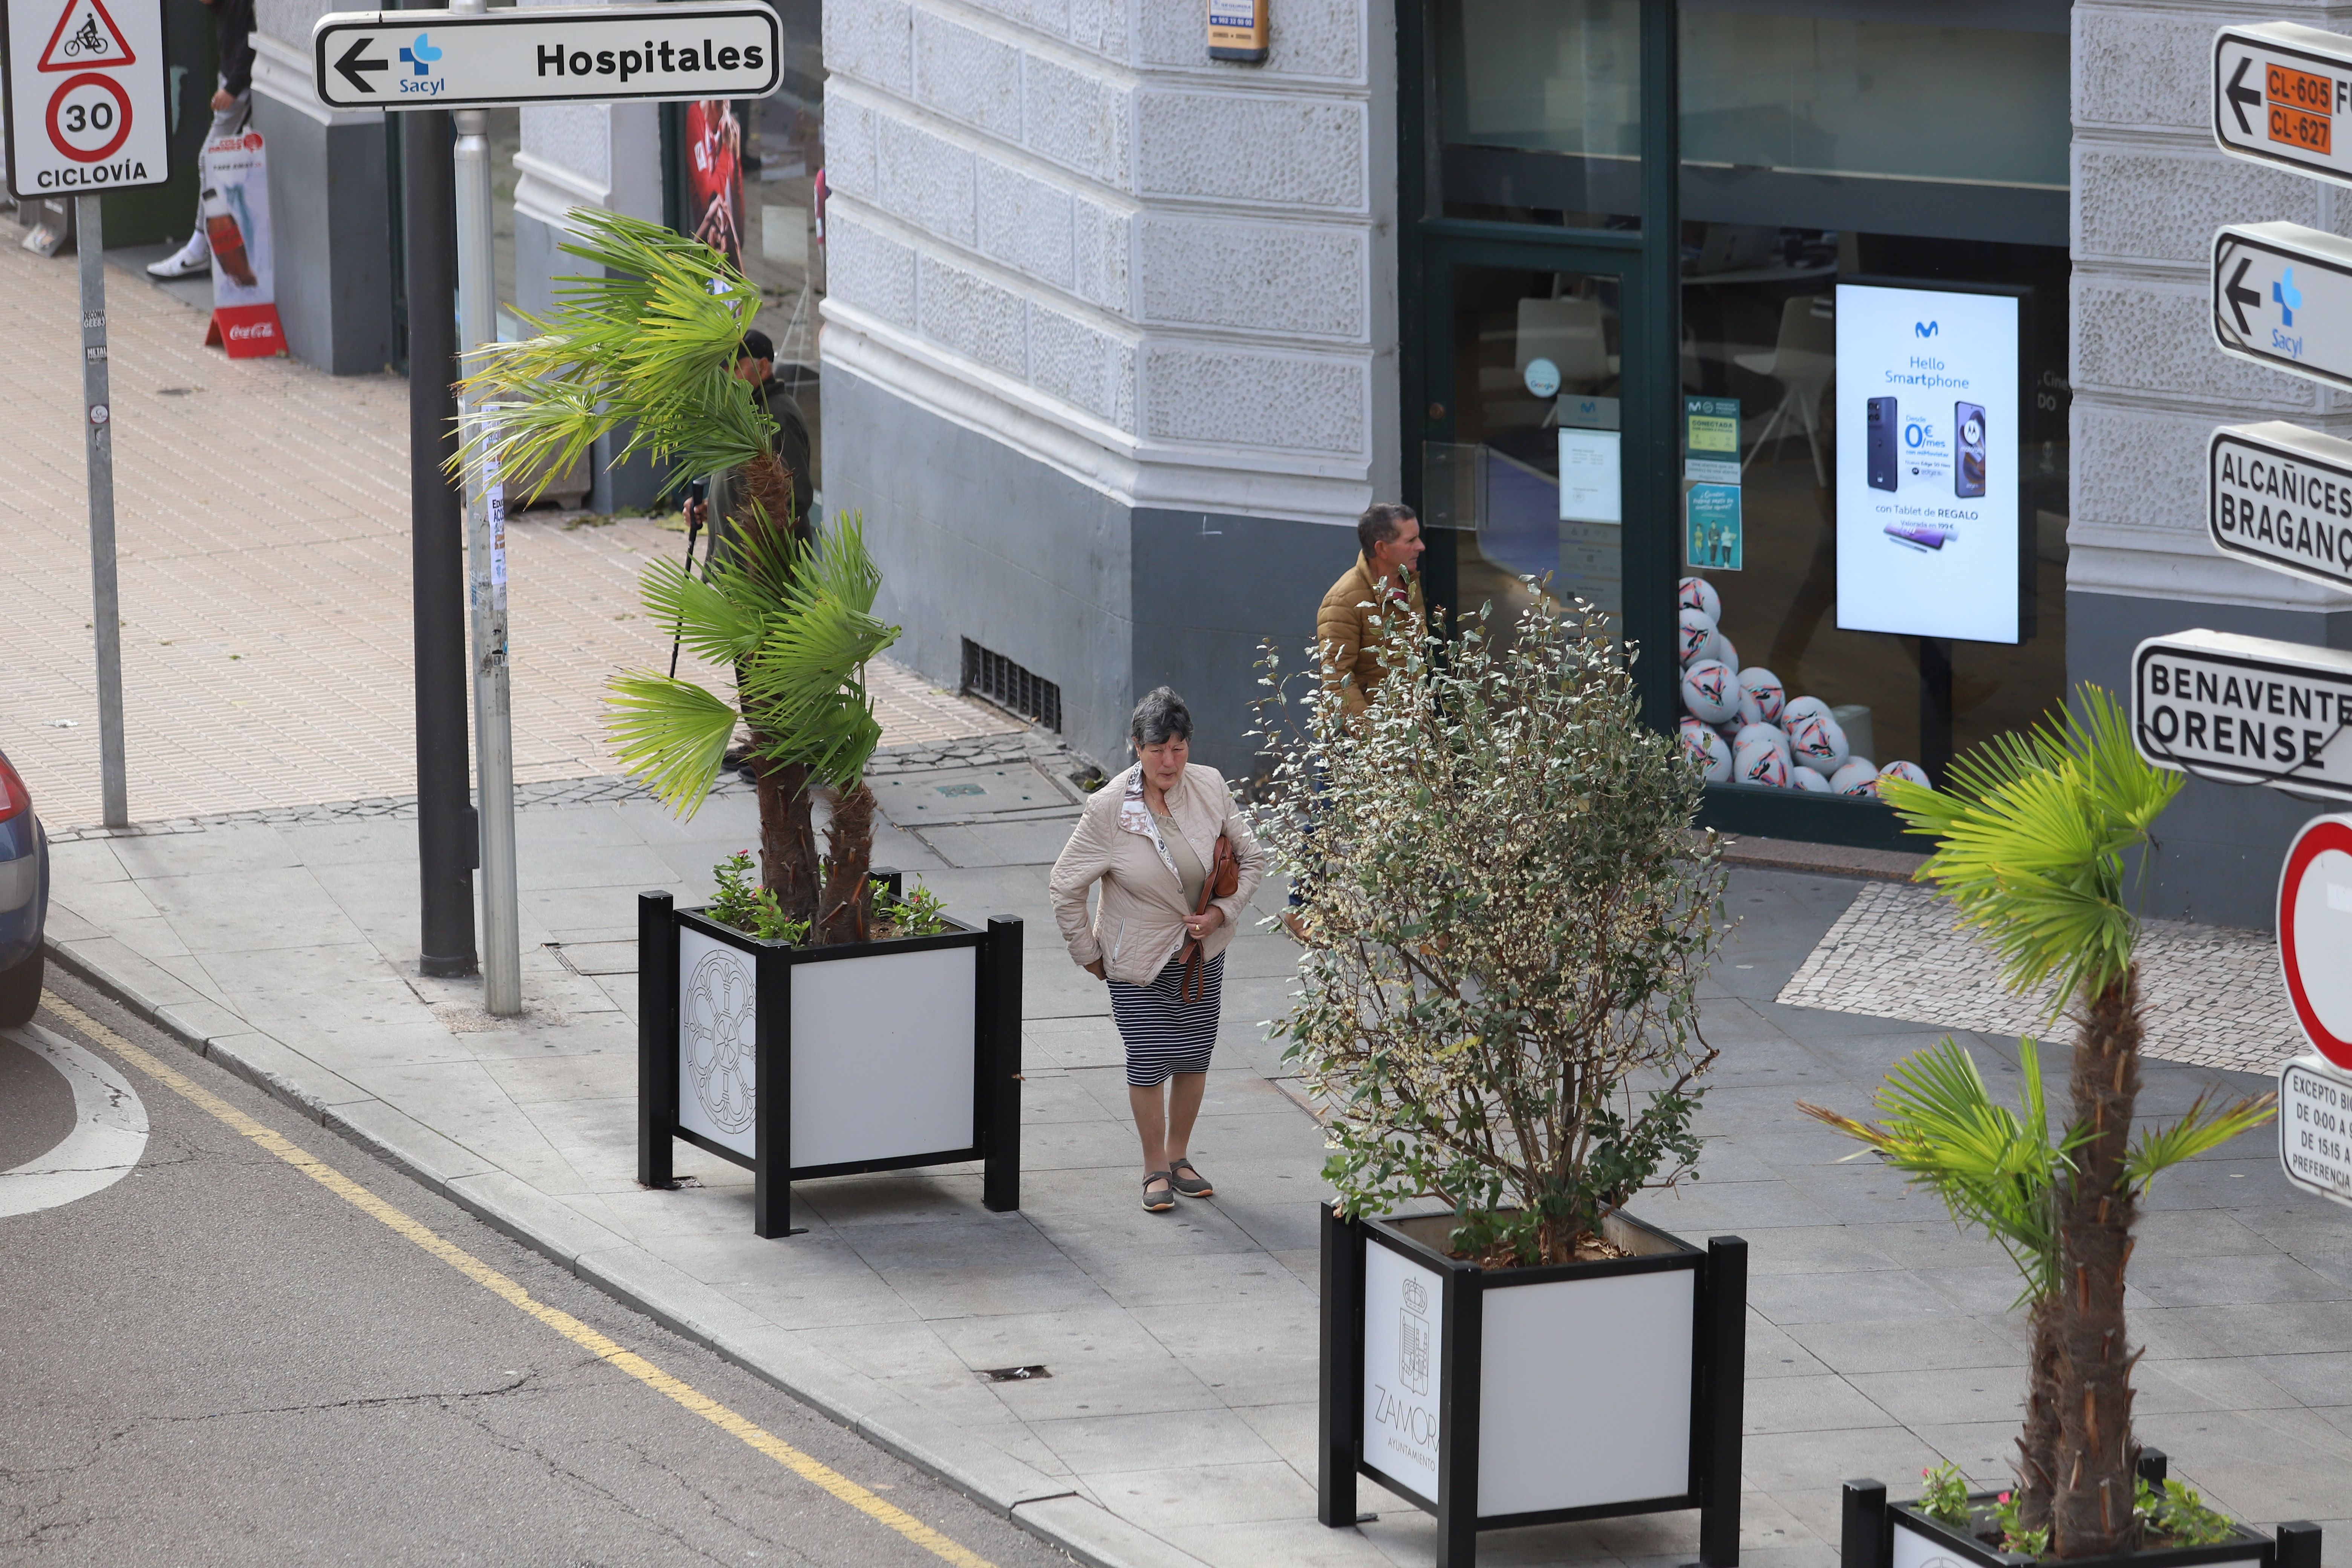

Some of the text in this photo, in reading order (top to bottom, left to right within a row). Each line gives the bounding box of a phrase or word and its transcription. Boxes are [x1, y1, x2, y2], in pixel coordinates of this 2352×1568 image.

[537, 39, 764, 82] Hospitales
[400, 78, 444, 96] Sacyl
[2269, 70, 2352, 114] CL-605 F
[66, 103, 113, 133] 30
[2271, 109, 2328, 148] CL-627
[37, 158, 148, 188] CICLOVÍA
[2272, 328, 2302, 359] Sacyl
[1885, 370, 1969, 389] Smartphone
[1910, 356, 1945, 371] Hello
[1530, 380, 1555, 391] Google
[2221, 452, 2352, 518] ALCAÑICES
[1876, 504, 1978, 521] con Tablet de REGALO
[1900, 519, 1927, 528] Valorada
[2151, 663, 2352, 726] BENAVENTE
[2152, 705, 2324, 769] ORENSE
[2293, 1075, 2336, 1106] EXCEPTO
[2297, 1102, 2309, 1123] DE
[2313, 1108, 2335, 1132] 0:00
[2339, 1118, 2346, 1137] A
[2301, 1130, 2350, 1165] DE 15:15 A
[2292, 1152, 2350, 1190] PREFERENCIA
[1375, 1384, 1439, 1453] ZAMOR
[1387, 1436, 1435, 1472] AYUNTAMIENTO
